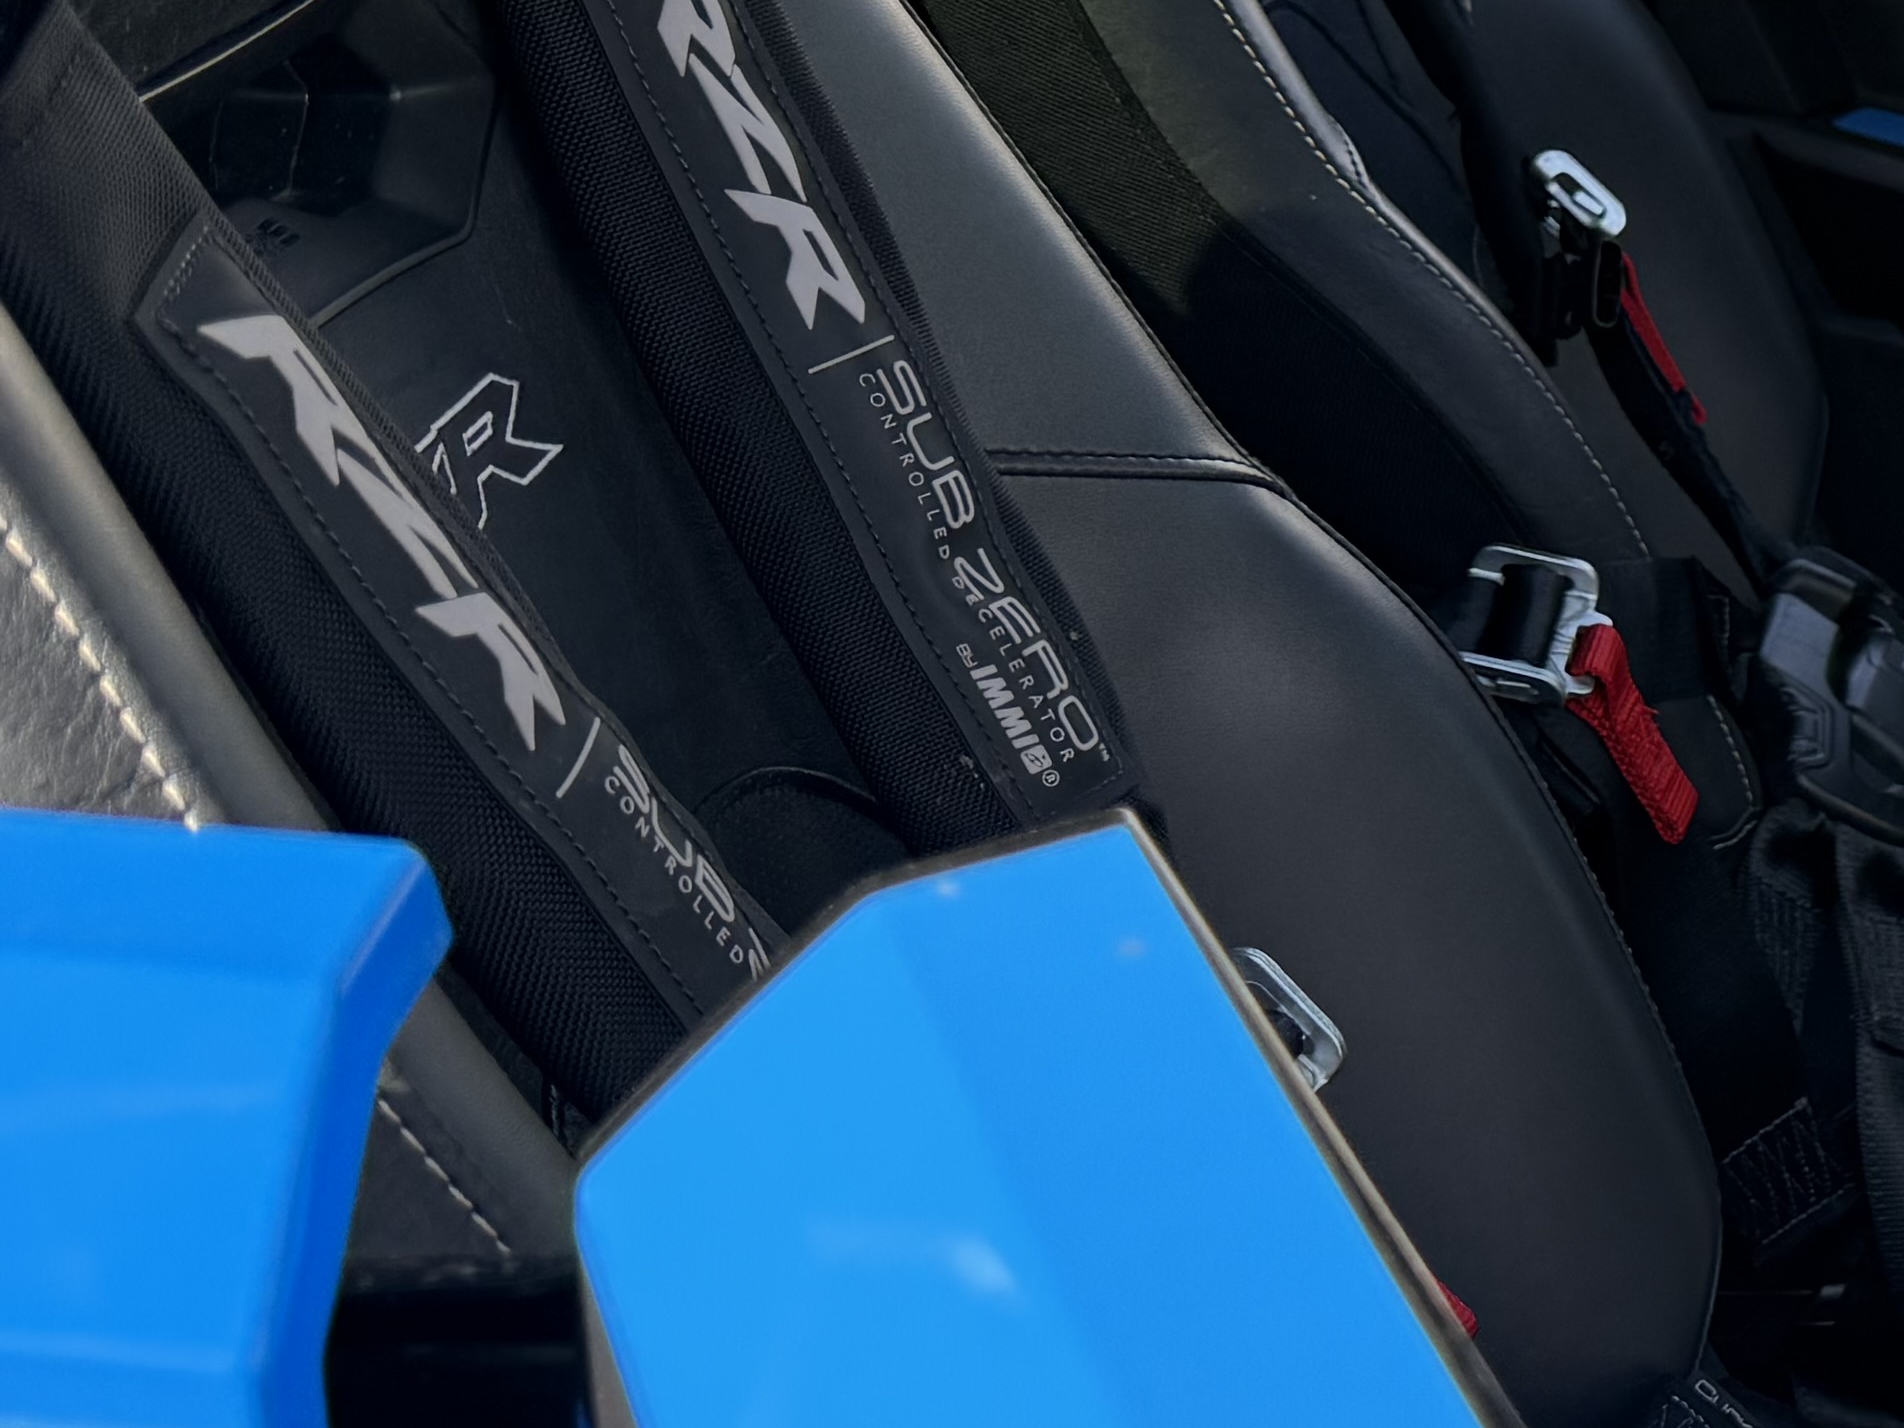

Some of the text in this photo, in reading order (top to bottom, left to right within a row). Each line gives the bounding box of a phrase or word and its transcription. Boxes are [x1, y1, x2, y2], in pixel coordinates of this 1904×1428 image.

[201, 312, 568, 755] RZR
[876, 358, 976, 533] SUB
[857, 372, 1076, 764] CONTROLLED DECELERATOR
[603, 774, 745, 966] CONTROLLED
[611, 742, 736, 925] SUB
